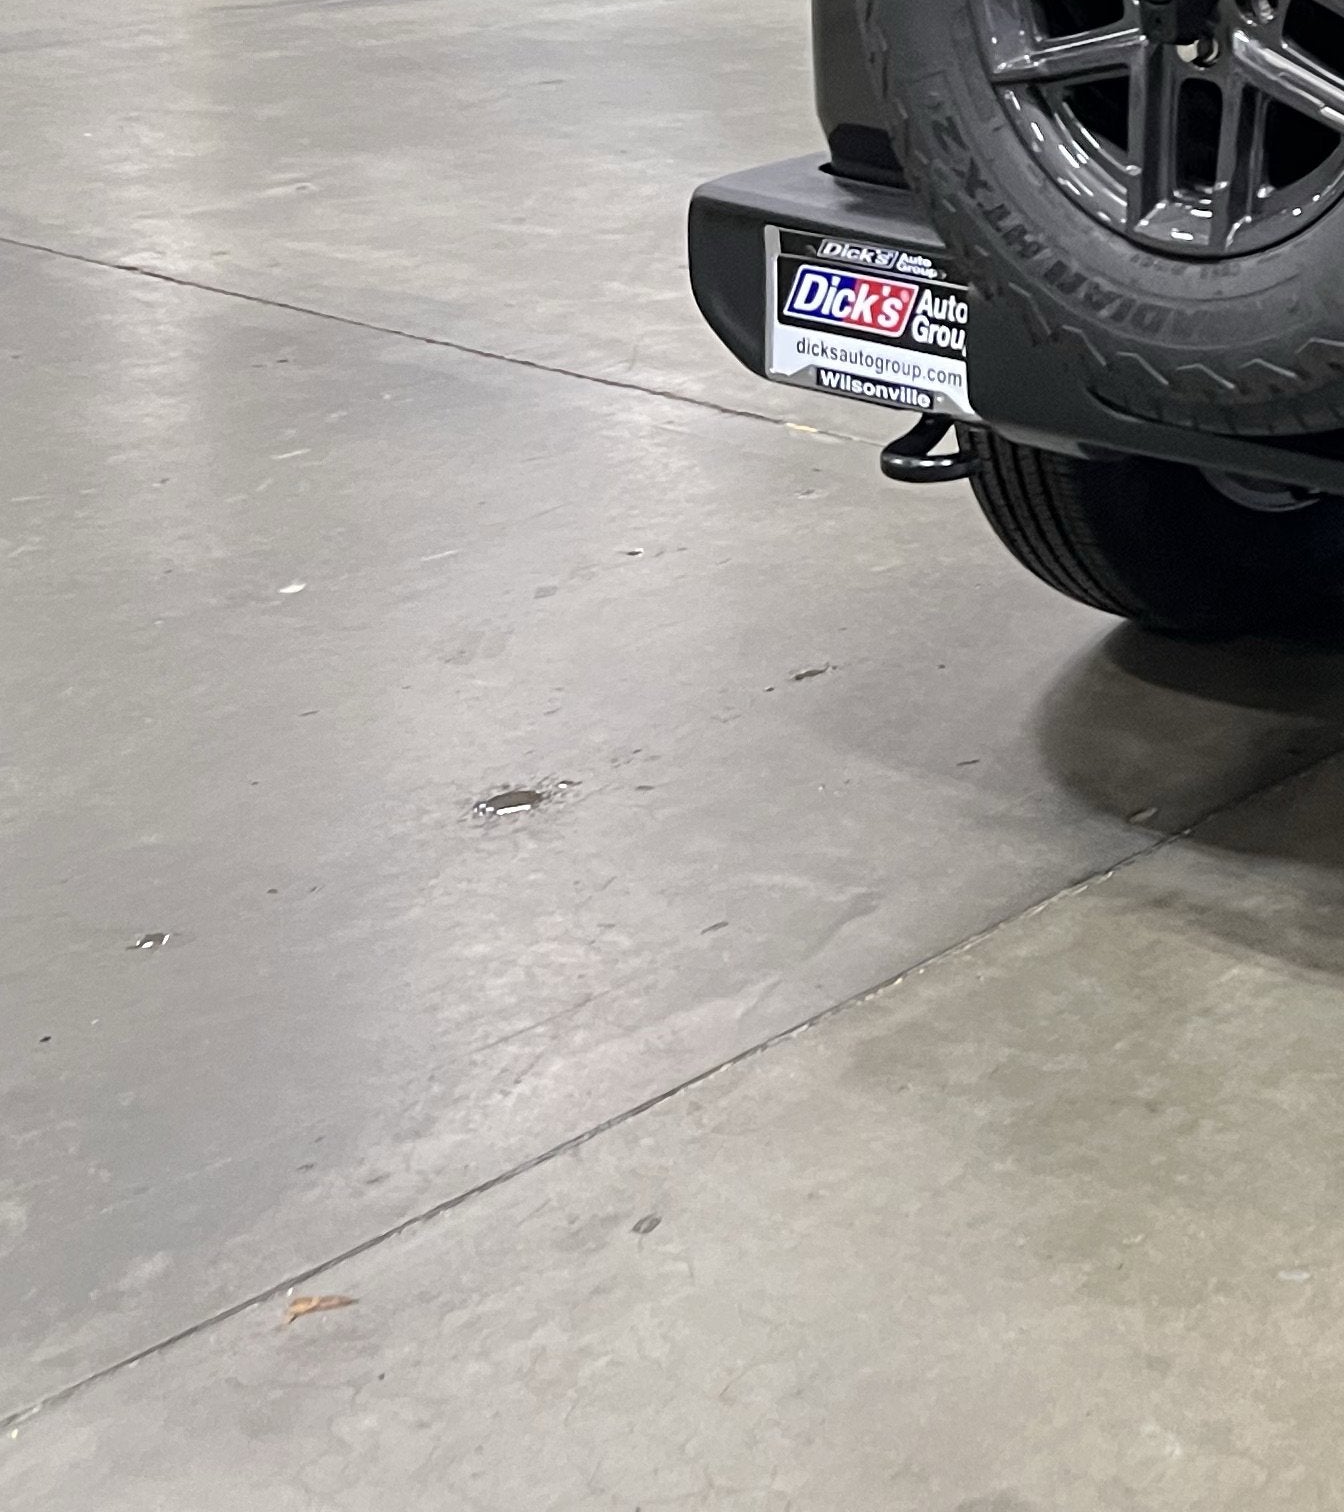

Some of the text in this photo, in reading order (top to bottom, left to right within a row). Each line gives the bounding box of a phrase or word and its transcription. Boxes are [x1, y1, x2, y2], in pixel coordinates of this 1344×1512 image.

[898, 253, 933, 268] Auto
[915, 288, 968, 324] Auto
[911, 315, 968, 357] Grou
[796, 337, 963, 388] dicksautogroup.com
[819, 368, 932, 409] Wilsonville
